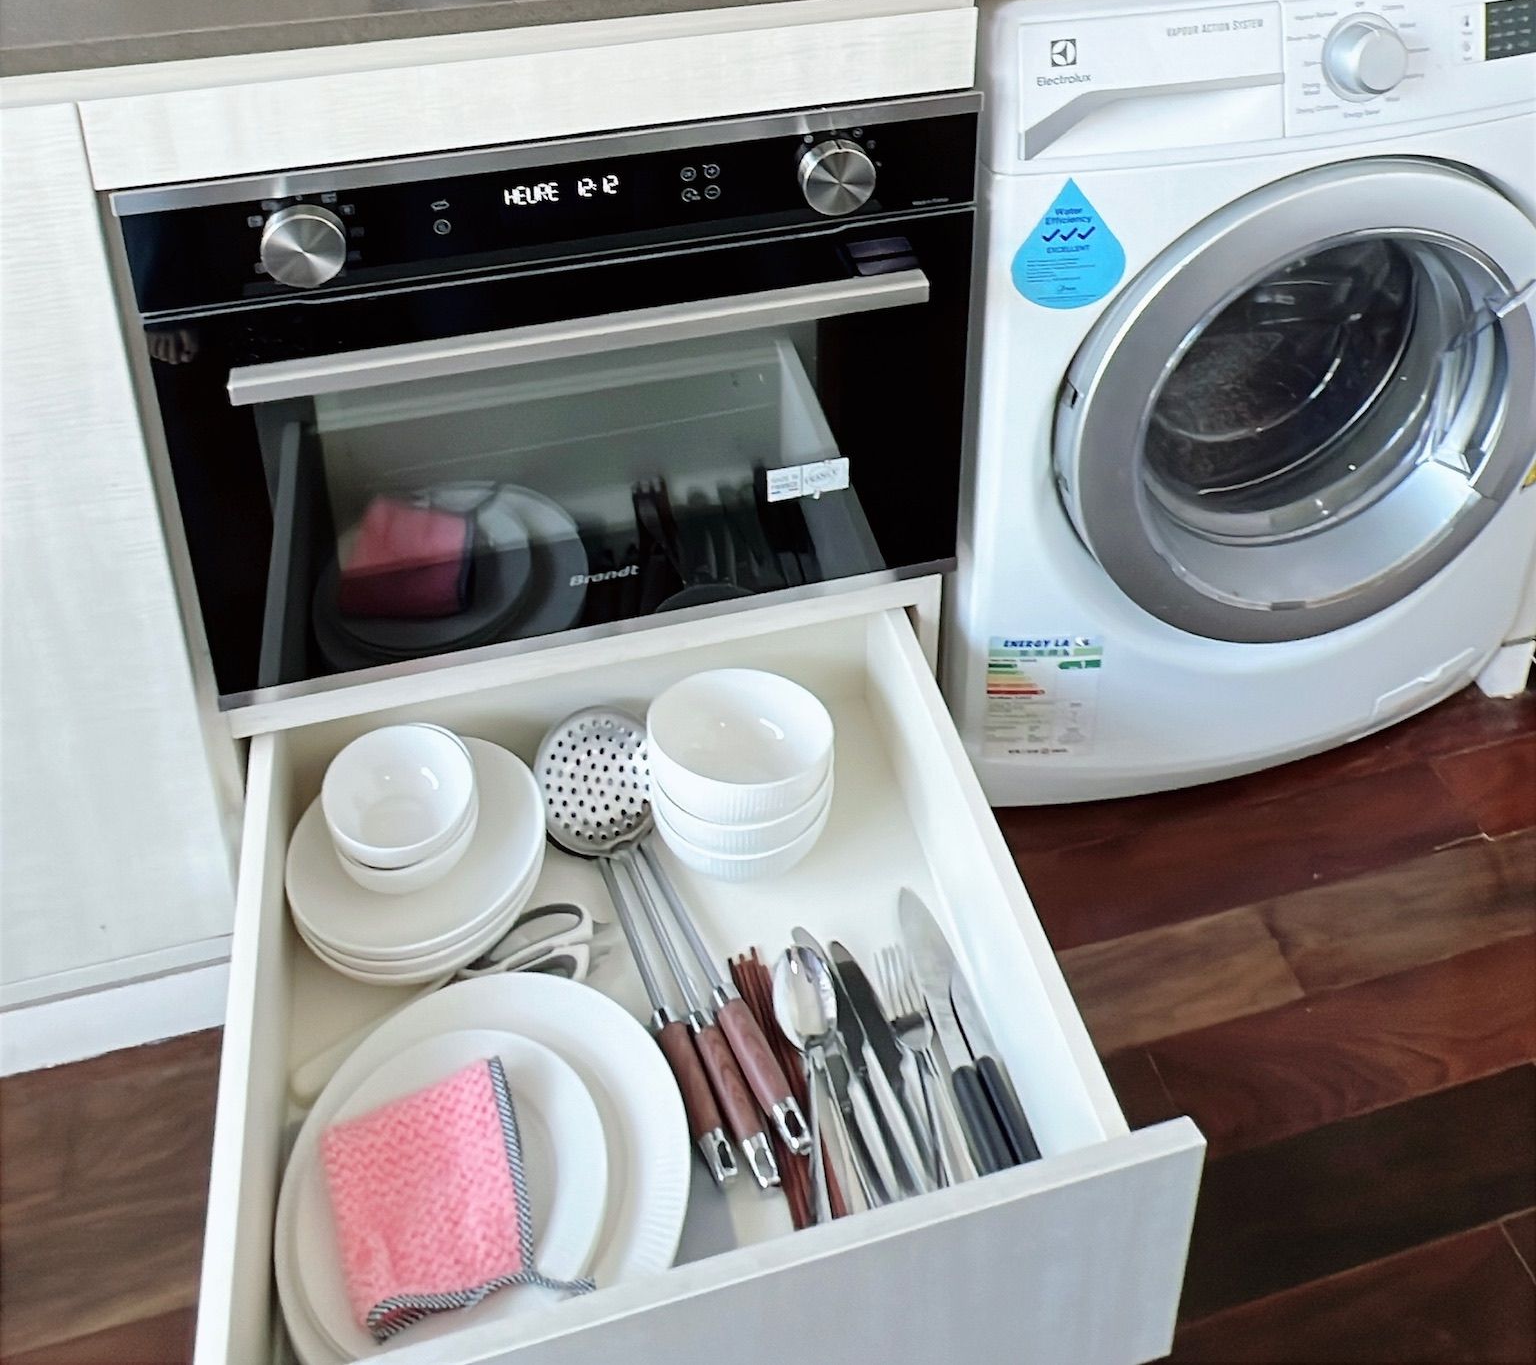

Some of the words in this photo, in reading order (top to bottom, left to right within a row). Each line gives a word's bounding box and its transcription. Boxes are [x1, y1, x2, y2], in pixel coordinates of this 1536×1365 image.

[1201, 22, 1230, 33] ACTION
[1036, 73, 1092, 87] Electrolux
[503, 182, 560, 206] HEURE
[577, 175, 619, 198] 12:12
[1055, 208, 1083, 216] Water
[1044, 216, 1092, 226] Efficiency
[1046, 245, 1090, 254] EXCELLENT
[569, 564, 640, 587] Brandt
[1003, 639, 1051, 648] ENERGY
